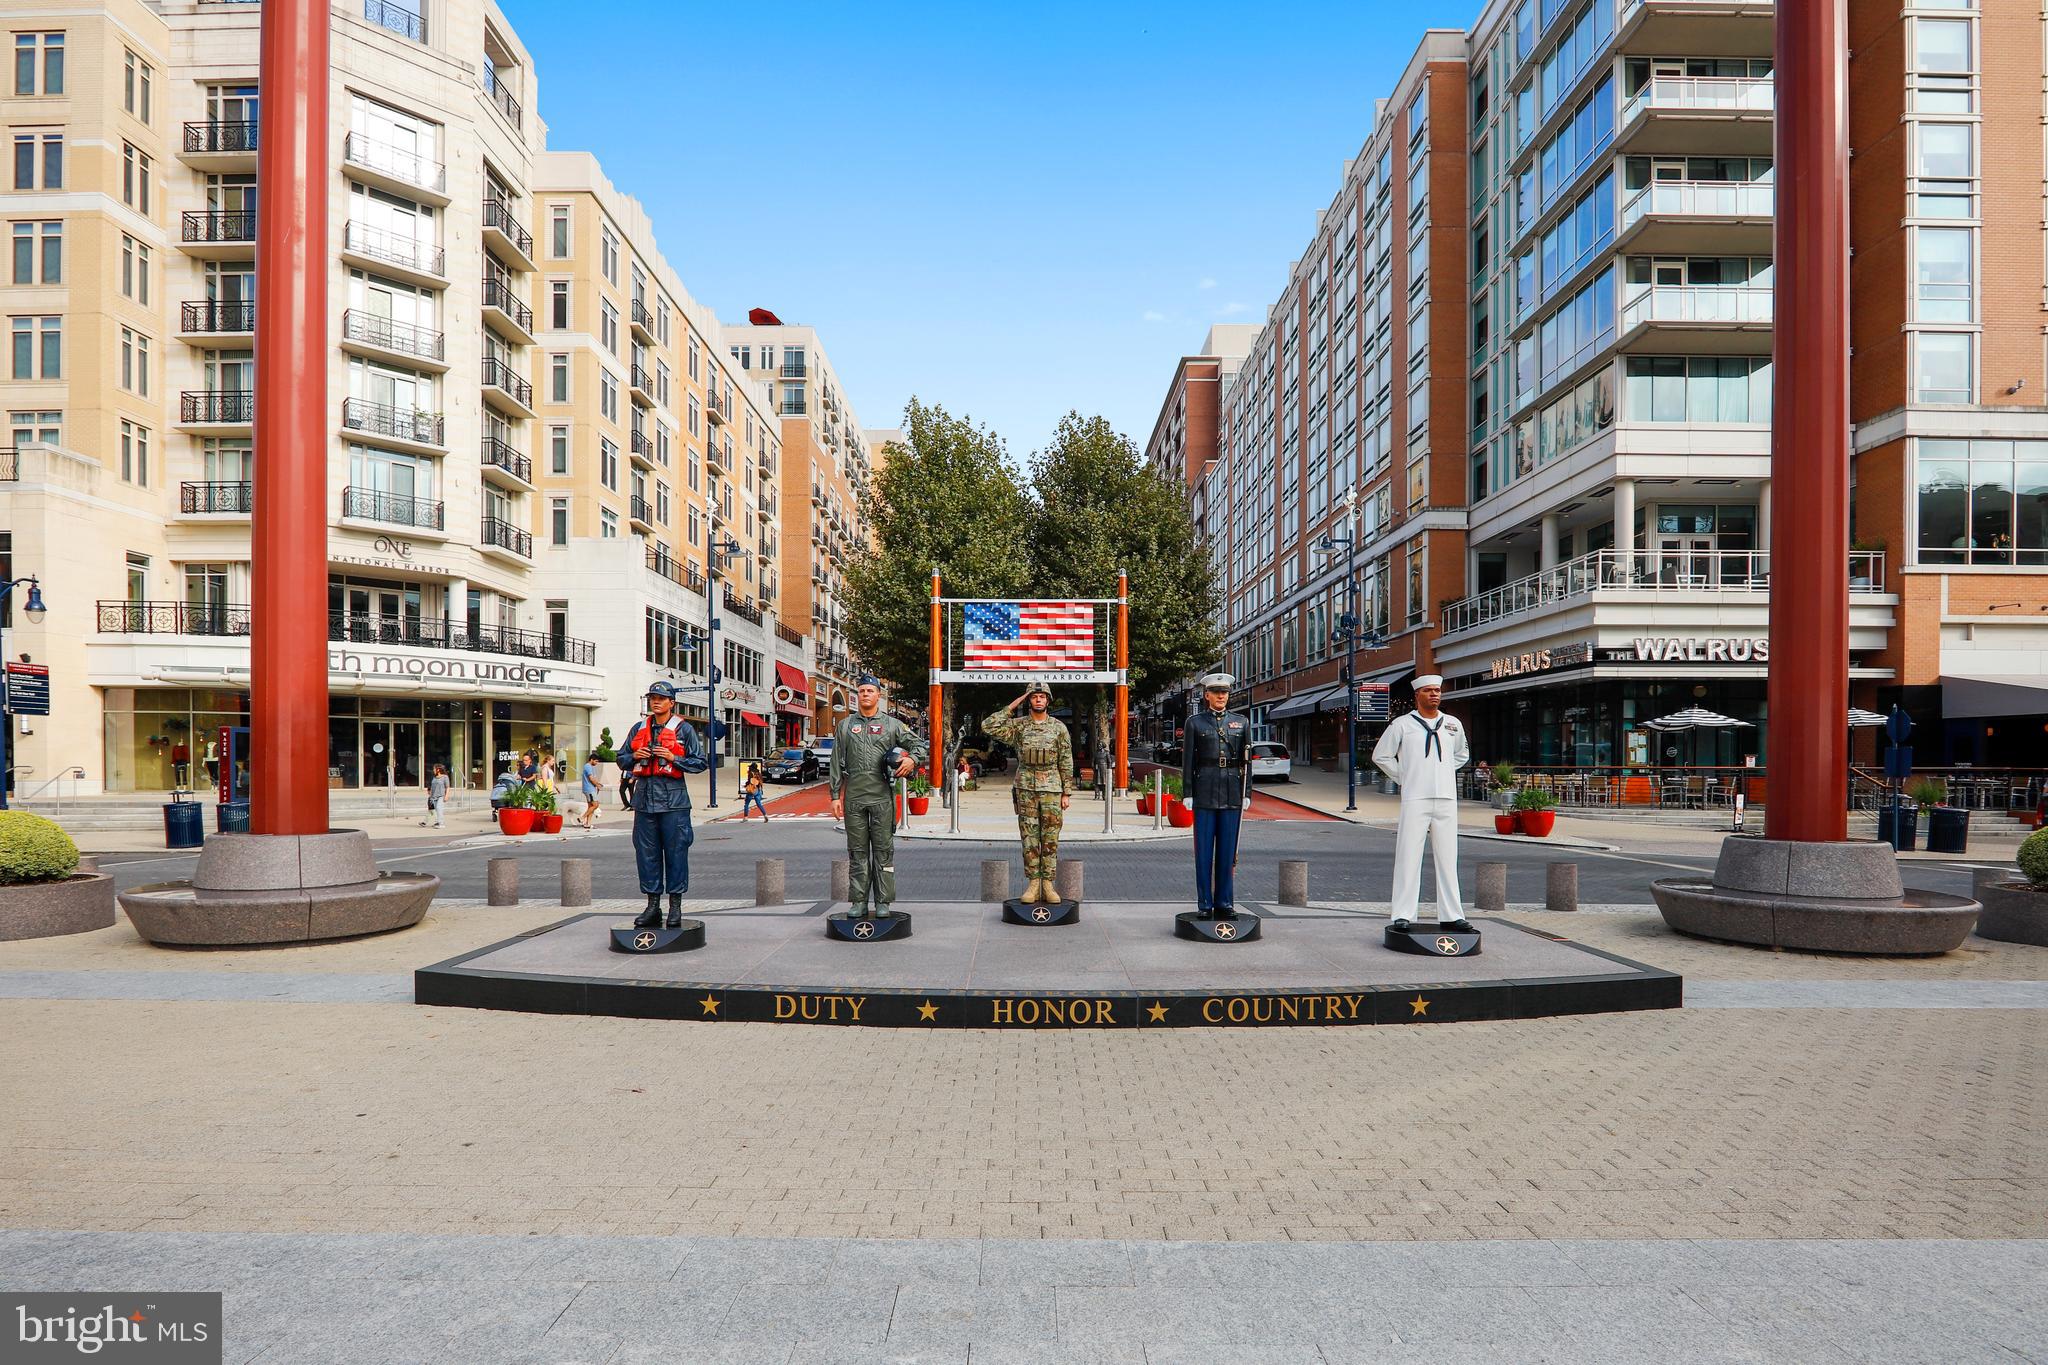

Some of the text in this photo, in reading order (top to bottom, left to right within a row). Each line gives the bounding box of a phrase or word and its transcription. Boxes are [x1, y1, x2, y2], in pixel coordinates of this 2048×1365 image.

[374, 536, 413, 559] ONE
[333, 555, 450, 574] NATIONAL HARBOR
[1606, 638, 1769, 661] THE WALRUS
[373, 656, 465, 677] moon
[474, 662, 551, 683] under
[1491, 649, 1551, 679] WALRUS
[774, 995, 1365, 1024] DUTY HONOR COUNTRY
